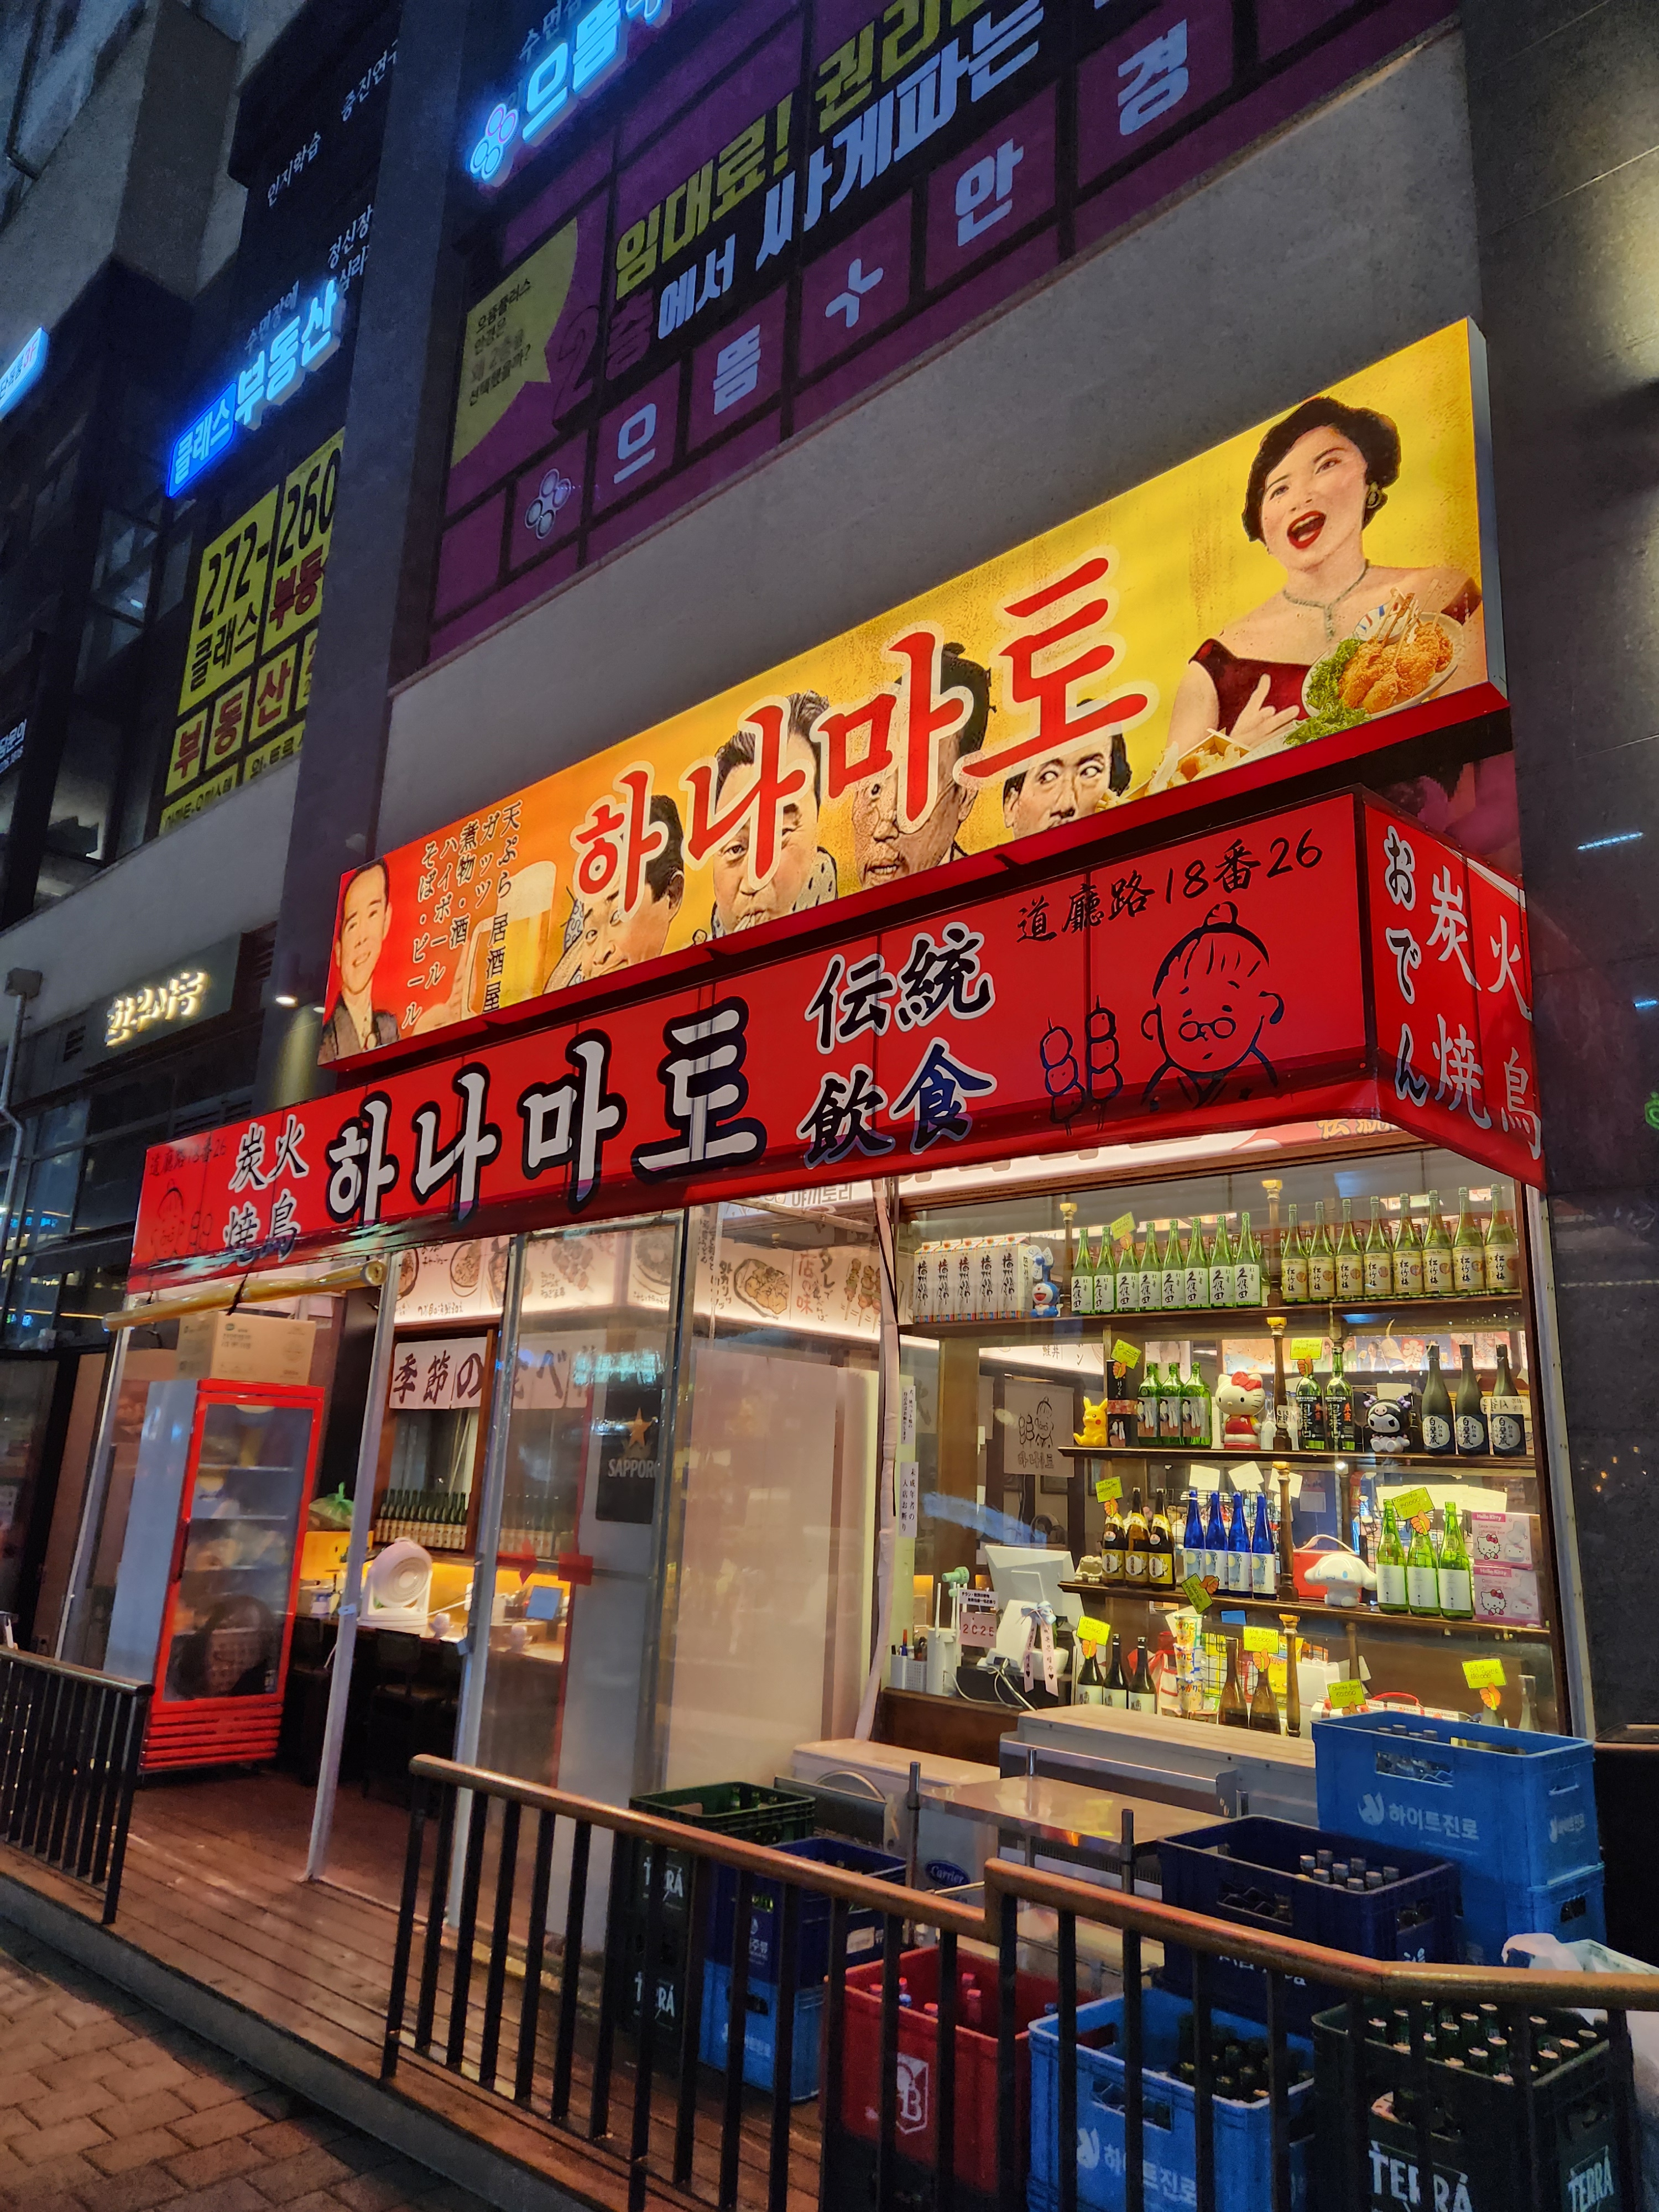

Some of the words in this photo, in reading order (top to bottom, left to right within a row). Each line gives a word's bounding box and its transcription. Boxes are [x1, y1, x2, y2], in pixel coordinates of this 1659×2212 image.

[268, 131, 321, 207] 인지학습
[616, 92, 791, 300] 임대료!
[815, 0, 989, 133] 권리
[175, 398, 230, 484] 클래스
[234, 279, 337, 425] 부동산
[191, 602, 258, 691] 클래스
[174, 658, 291, 779] 부동산
[575, 553, 1153, 918] 하나마토
[497, 800, 523, 899] 天ぷら
[401, 839, 439, 1030] そば・ビール
[425, 837, 458, 990] ハイボール
[1384, 825, 1430, 1107] おでん
[1426, 865, 1531, 1021] 炭火
[805, 921, 995, 1055] 伝統
[326, 995, 768, 1229] 하나마토
[796, 1036, 997, 1170] 飲食
[1432, 1014, 1542, 1161] 焼鳥
[228, 1113, 310, 1193] 炭火
[223, 1188, 302, 1267] 焼鳥
[1073, 1279, 1082, 1307] 久保田
[1094, 1279, 1103, 1307] 久保田
[1119, 1276, 1129, 1305] 久保田
[1141, 1274, 1150, 1303] 久保田
[1164, 1272, 1173, 1303] 久保田
[1187, 1271, 1197, 1301] 久保田
[1213, 1269, 1224, 1300] 久保田
[1237, 1267, 1248, 1298] 久保田
[1286, 1266, 1295, 1292] 松竹梅
[1313, 1265, 1322, 1291] 松竹梅
[1340, 1263, 1349, 1289] 松竹梅
[1368, 1261, 1377, 1287] 松竹梅
[1399, 1259, 1410, 1286] 松竹梅
[1428, 1258, 1438, 1285] 松竹梅
[1460, 1255, 1471, 1282] 松竹梅
[1494, 1253, 1506, 1280] 松竹梅
[393, 1349, 484, 1404] 季節の
[1389, 1803, 1480, 1841] 하이트진로
[930, 1864, 965, 1884] Carrier
[1104, 2143, 1197, 2207] 하트진로
